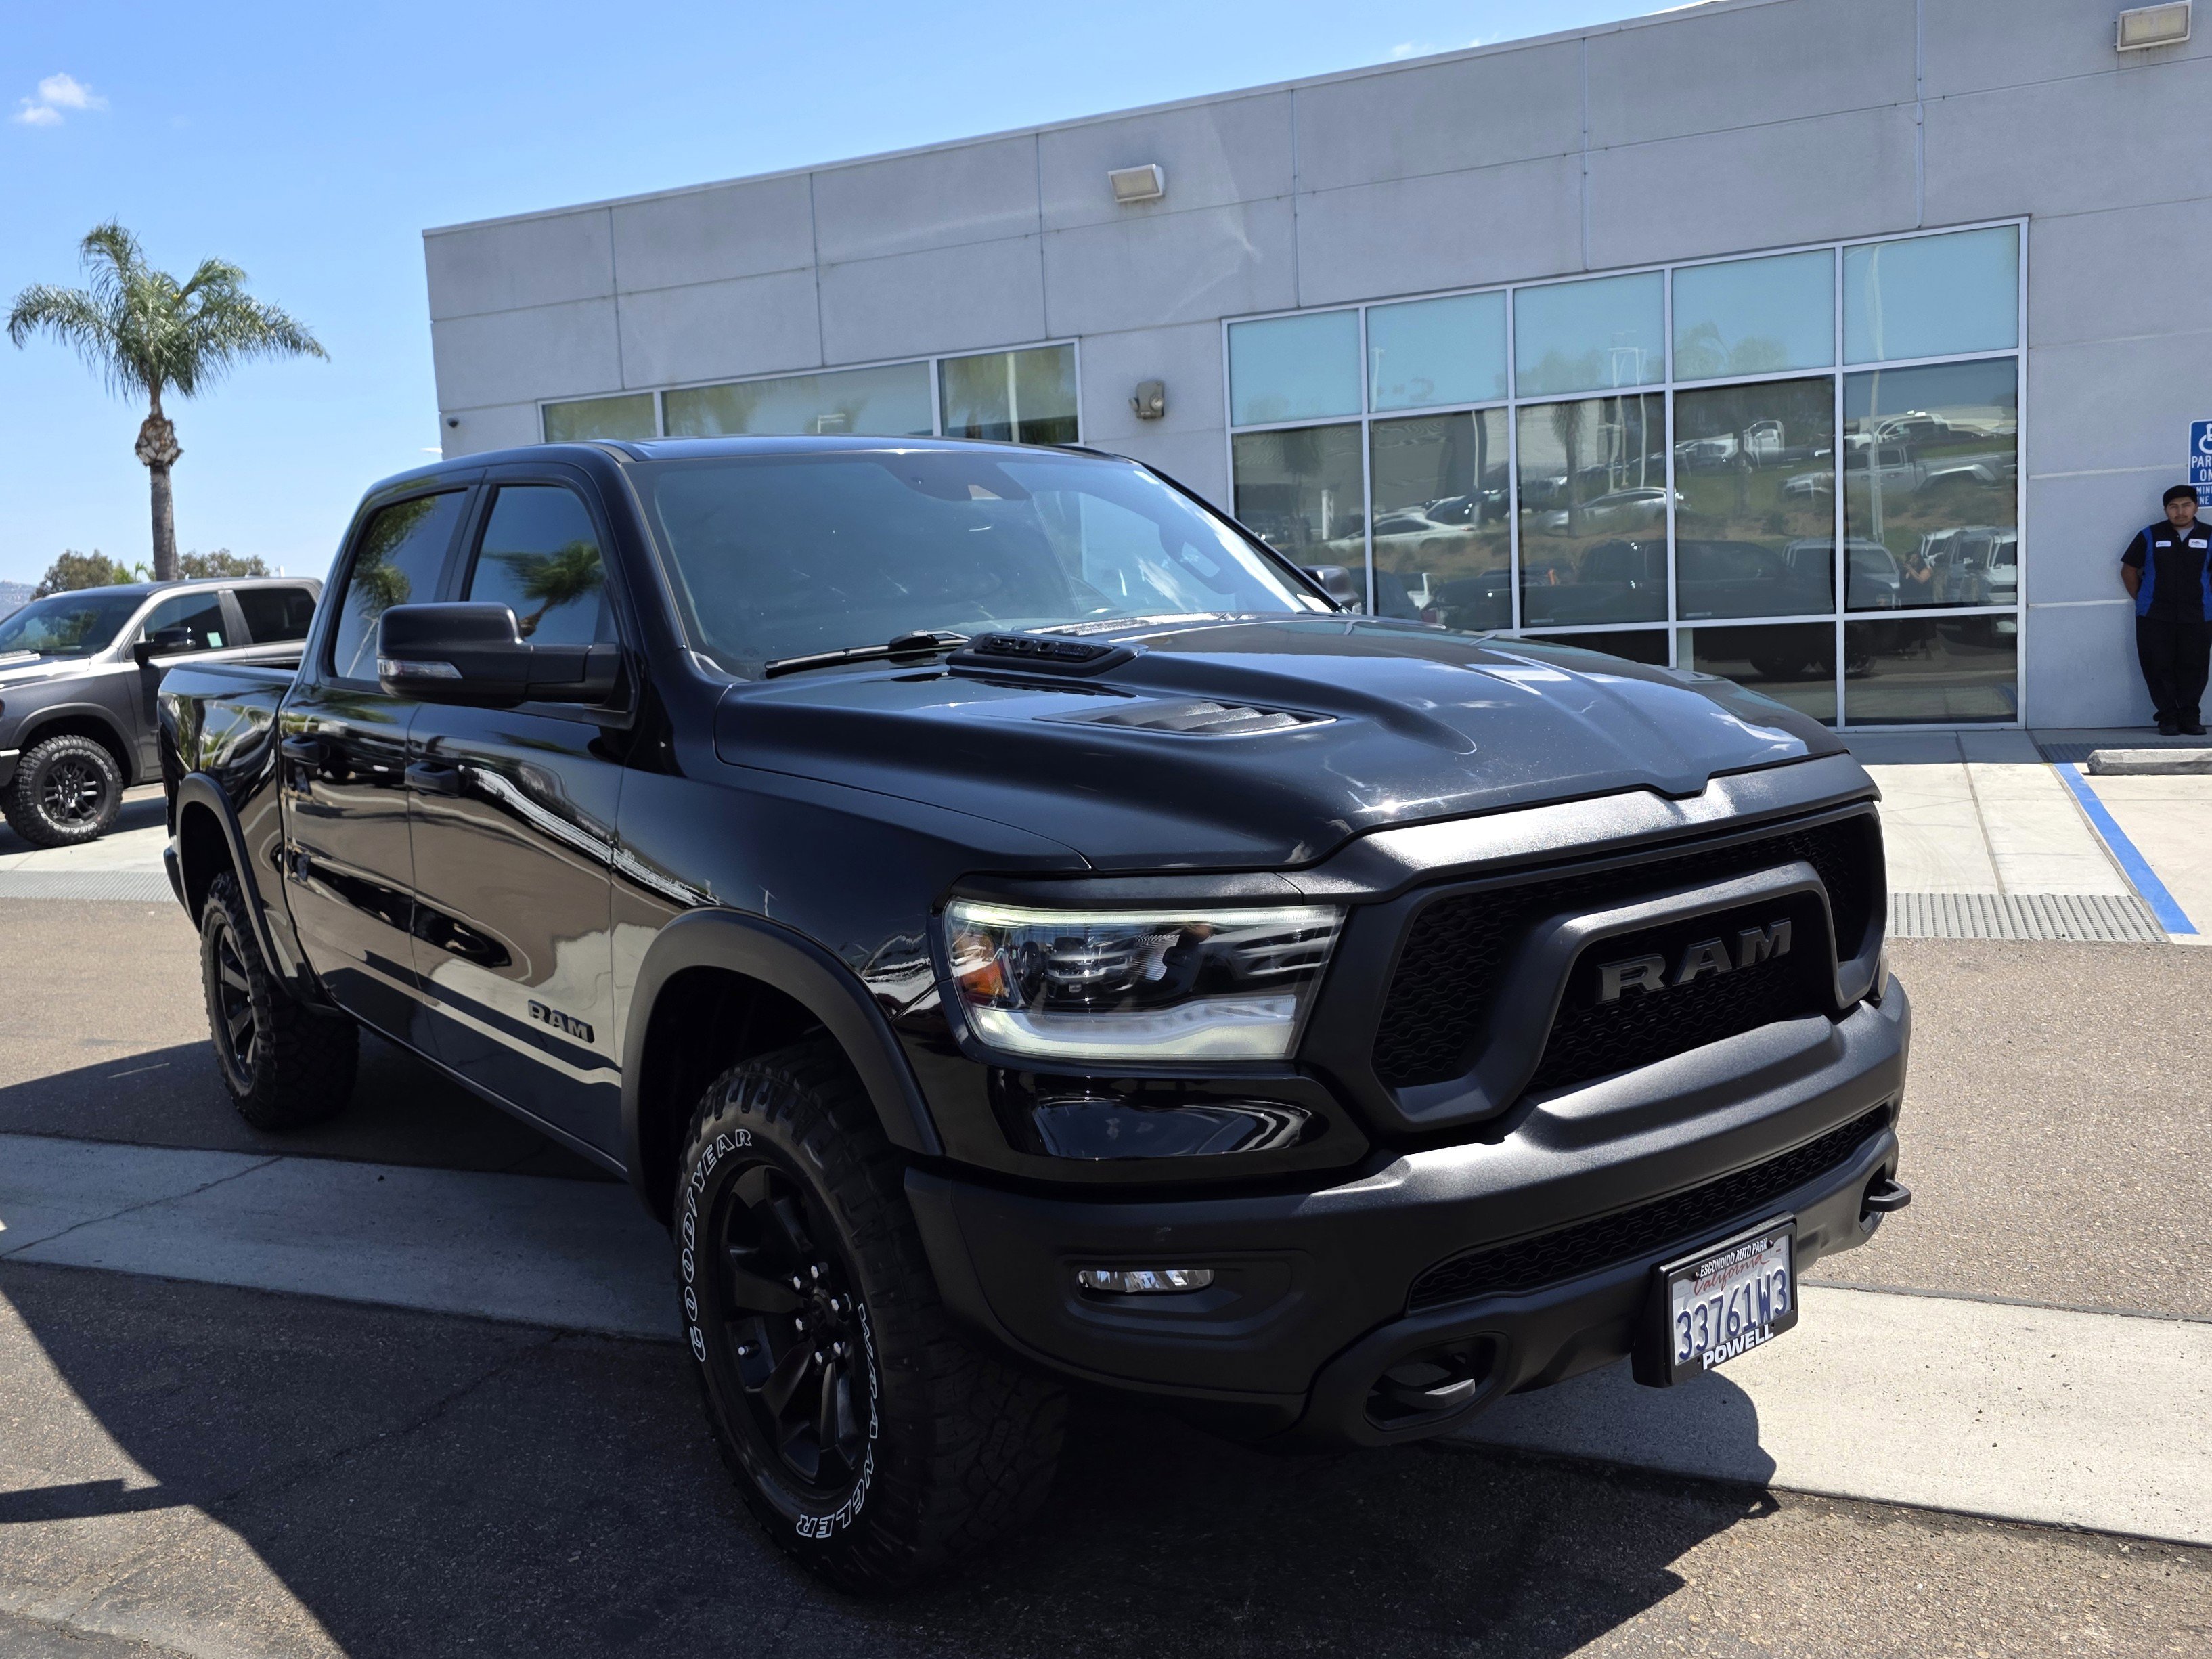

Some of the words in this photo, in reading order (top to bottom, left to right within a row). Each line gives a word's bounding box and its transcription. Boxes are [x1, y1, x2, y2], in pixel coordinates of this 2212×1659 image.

[1596, 917, 1792, 1004] RAM
[528, 999, 595, 1043] RAM
[682, 1128, 752, 1362] GOODYEAR
[1694, 1254, 1770, 1296] California
[1700, 1252, 1735, 1277] ESCONDIDO
[1735, 1244, 1752, 1263] AUTO
[1751, 1237, 1768, 1256] PARK
[1677, 1268, 1787, 1361] 33761W3
[1702, 1324, 1774, 1370] POWELL
[795, 1303, 878, 1539] WRANGLER
